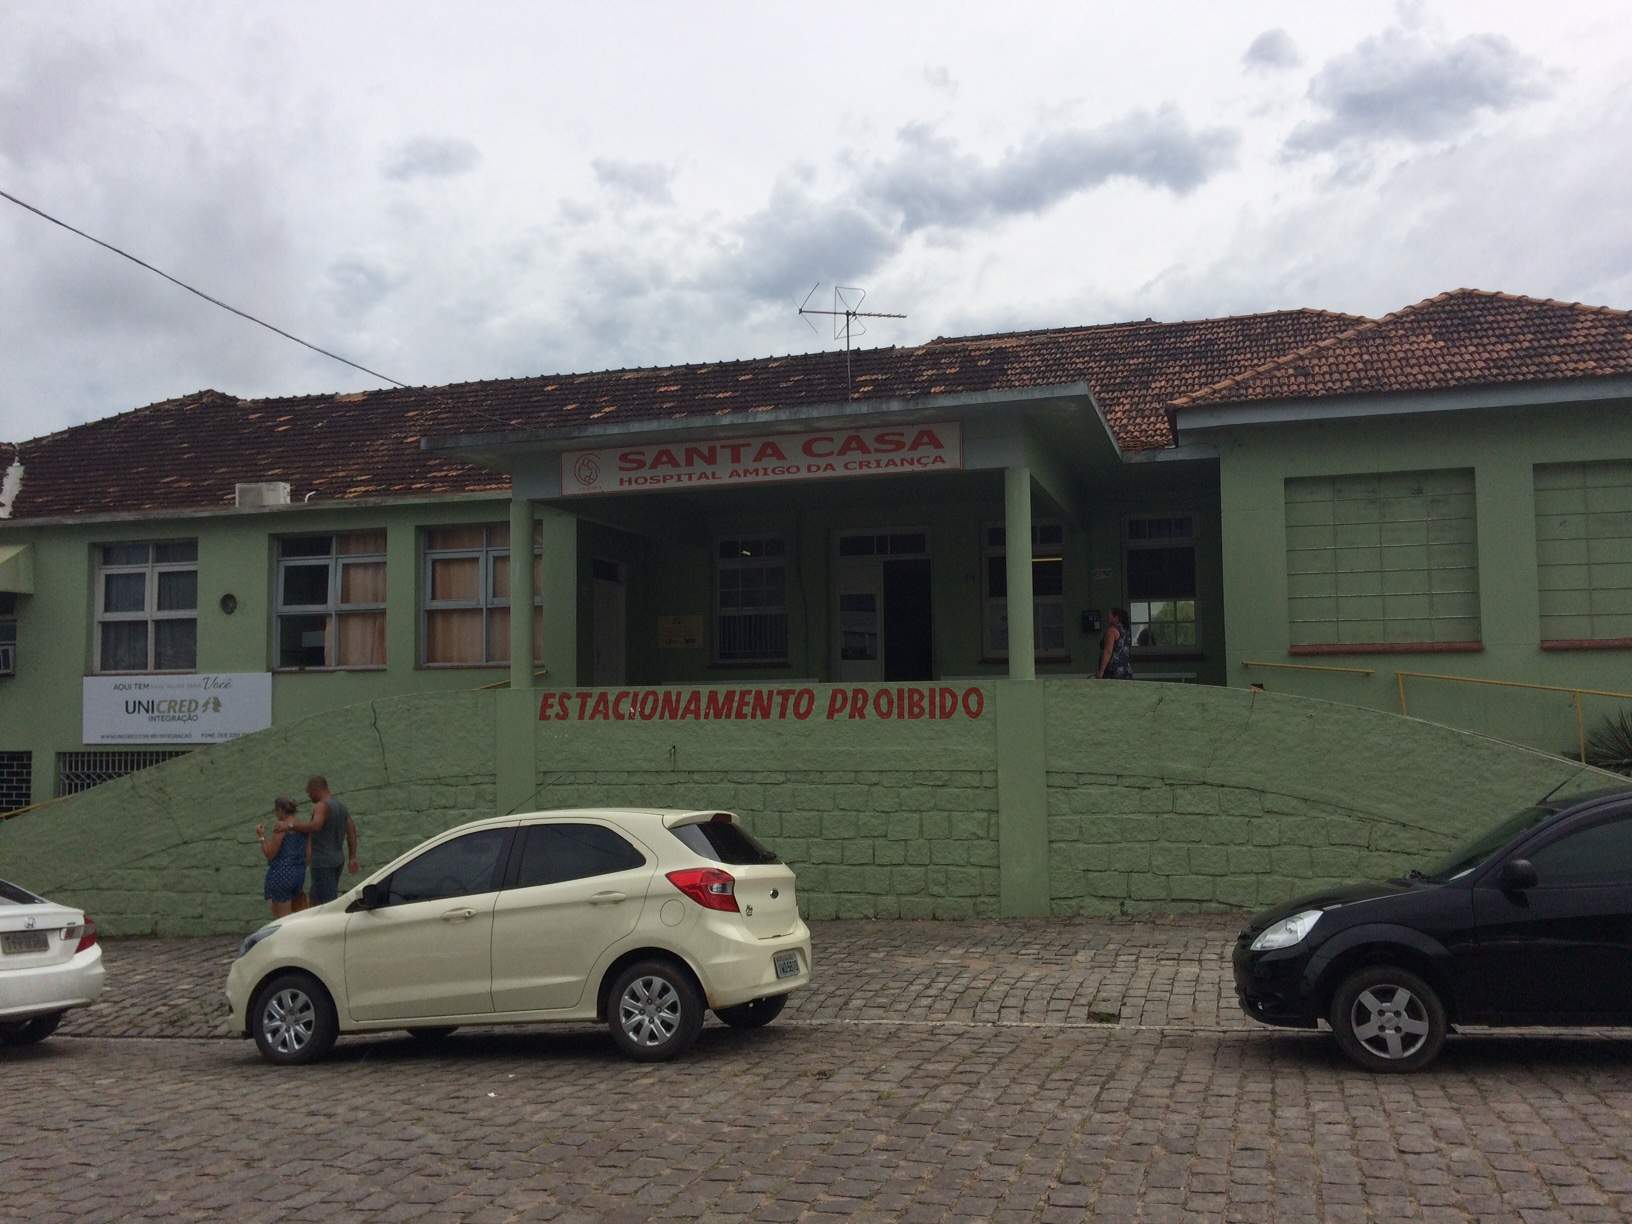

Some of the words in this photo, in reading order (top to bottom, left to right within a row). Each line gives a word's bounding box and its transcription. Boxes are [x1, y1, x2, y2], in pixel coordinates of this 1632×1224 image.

[618, 441, 787, 473] SANTA
[801, 429, 945, 458] CASA
[619, 472, 722, 487] HOSPITAL
[728, 466, 801, 480] AMIGO
[806, 463, 836, 474] DA
[843, 455, 947, 472] CRIANÇA
[125, 699, 199, 714] UNICRED
[539, 688, 814, 721] ESTACIONAMENTO
[828, 687, 985, 721] PROIBIDO
